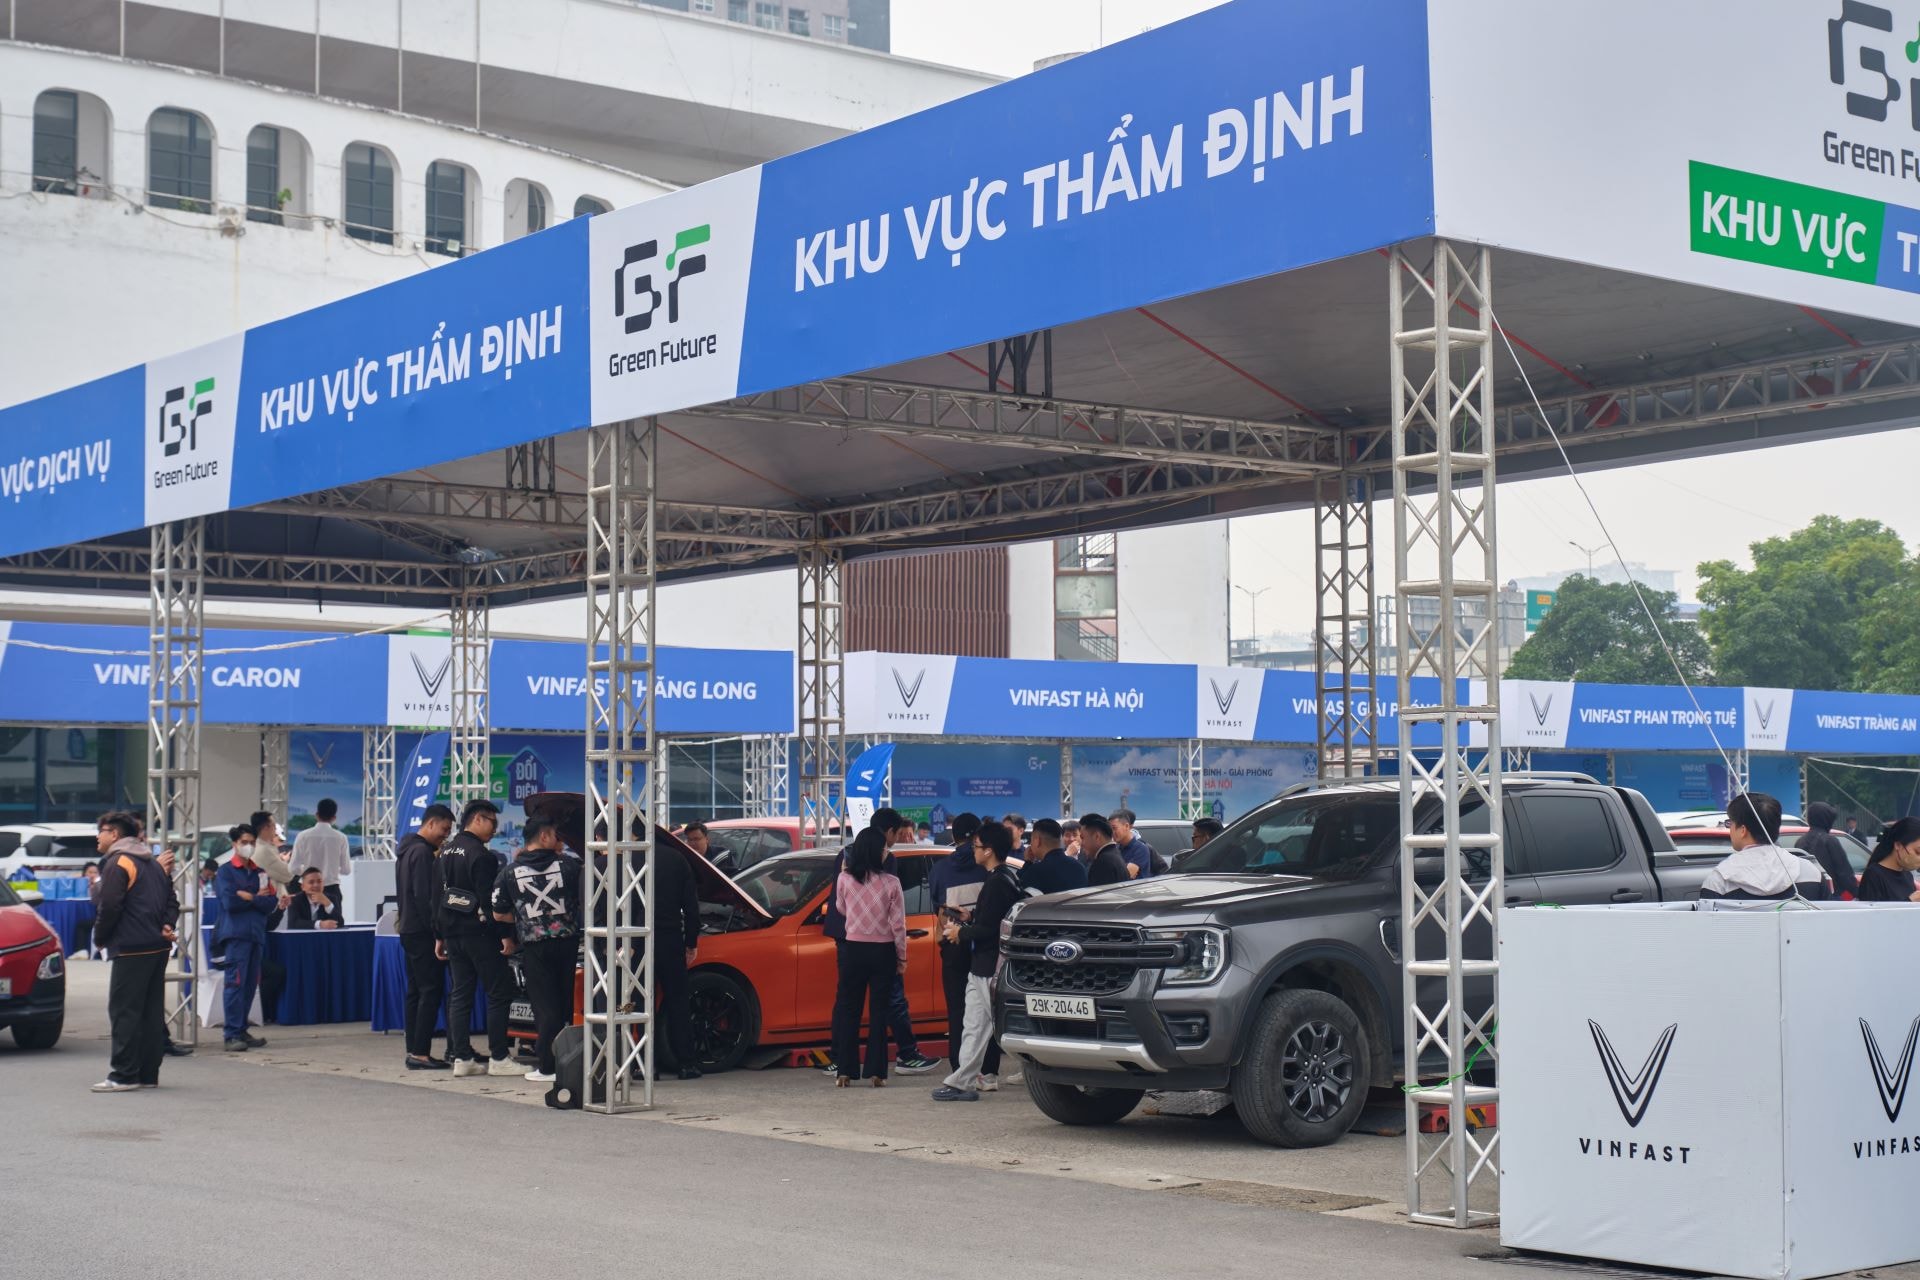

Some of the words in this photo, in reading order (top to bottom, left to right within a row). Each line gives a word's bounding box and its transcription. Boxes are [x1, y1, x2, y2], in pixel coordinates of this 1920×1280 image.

[1823, 130, 1895, 176] Green
[795, 213, 889, 292] KHU
[904, 177, 1007, 267] VỰC
[1023, 114, 1183, 228] THẨM
[1203, 65, 1365, 183] ĐỊNH
[1702, 191, 1781, 246] KHU
[1792, 212, 1866, 269] VỰC
[610, 345, 657, 377] Green
[661, 334, 717, 365] Future
[260, 380, 314, 432] KHU
[321, 357, 379, 422] VỰC
[387, 322, 471, 398] THẨM
[480, 306, 562, 379] ĐỊNH
[1, 457, 35, 503] VỰC
[38, 447, 80, 494] DỊCH
[85, 439, 111, 482] VỤ
[154, 467, 183, 488] Green
[185, 461, 218, 482] Future
[211, 666, 301, 688] CARON
[702, 681, 757, 699] LONG
[1009, 688, 1081, 707] VINFAST
[1085, 687, 1110, 708] HÀ
[1115, 688, 1144, 712] NỘI
[404, 703, 450, 712] VINFAS
[1579, 708, 1631, 724] VINFAST
[1634, 711, 1668, 724] PHAN
[1671, 711, 1712, 728] TRỌNG
[1715, 707, 1737, 728] TUỆ
[1206, 719, 1242, 727] VINFAST
[1816, 714, 1861, 730] VINFAST
[1864, 713, 1899, 731] TRÀNG
[1901, 718, 1917, 731] AN
[515, 755, 537, 781] ĐỔI
[1128, 768, 1161, 777] VINFAST
[1051, 945, 1069, 957] Ford
[1579, 1137, 1690, 1164] VINFAST
